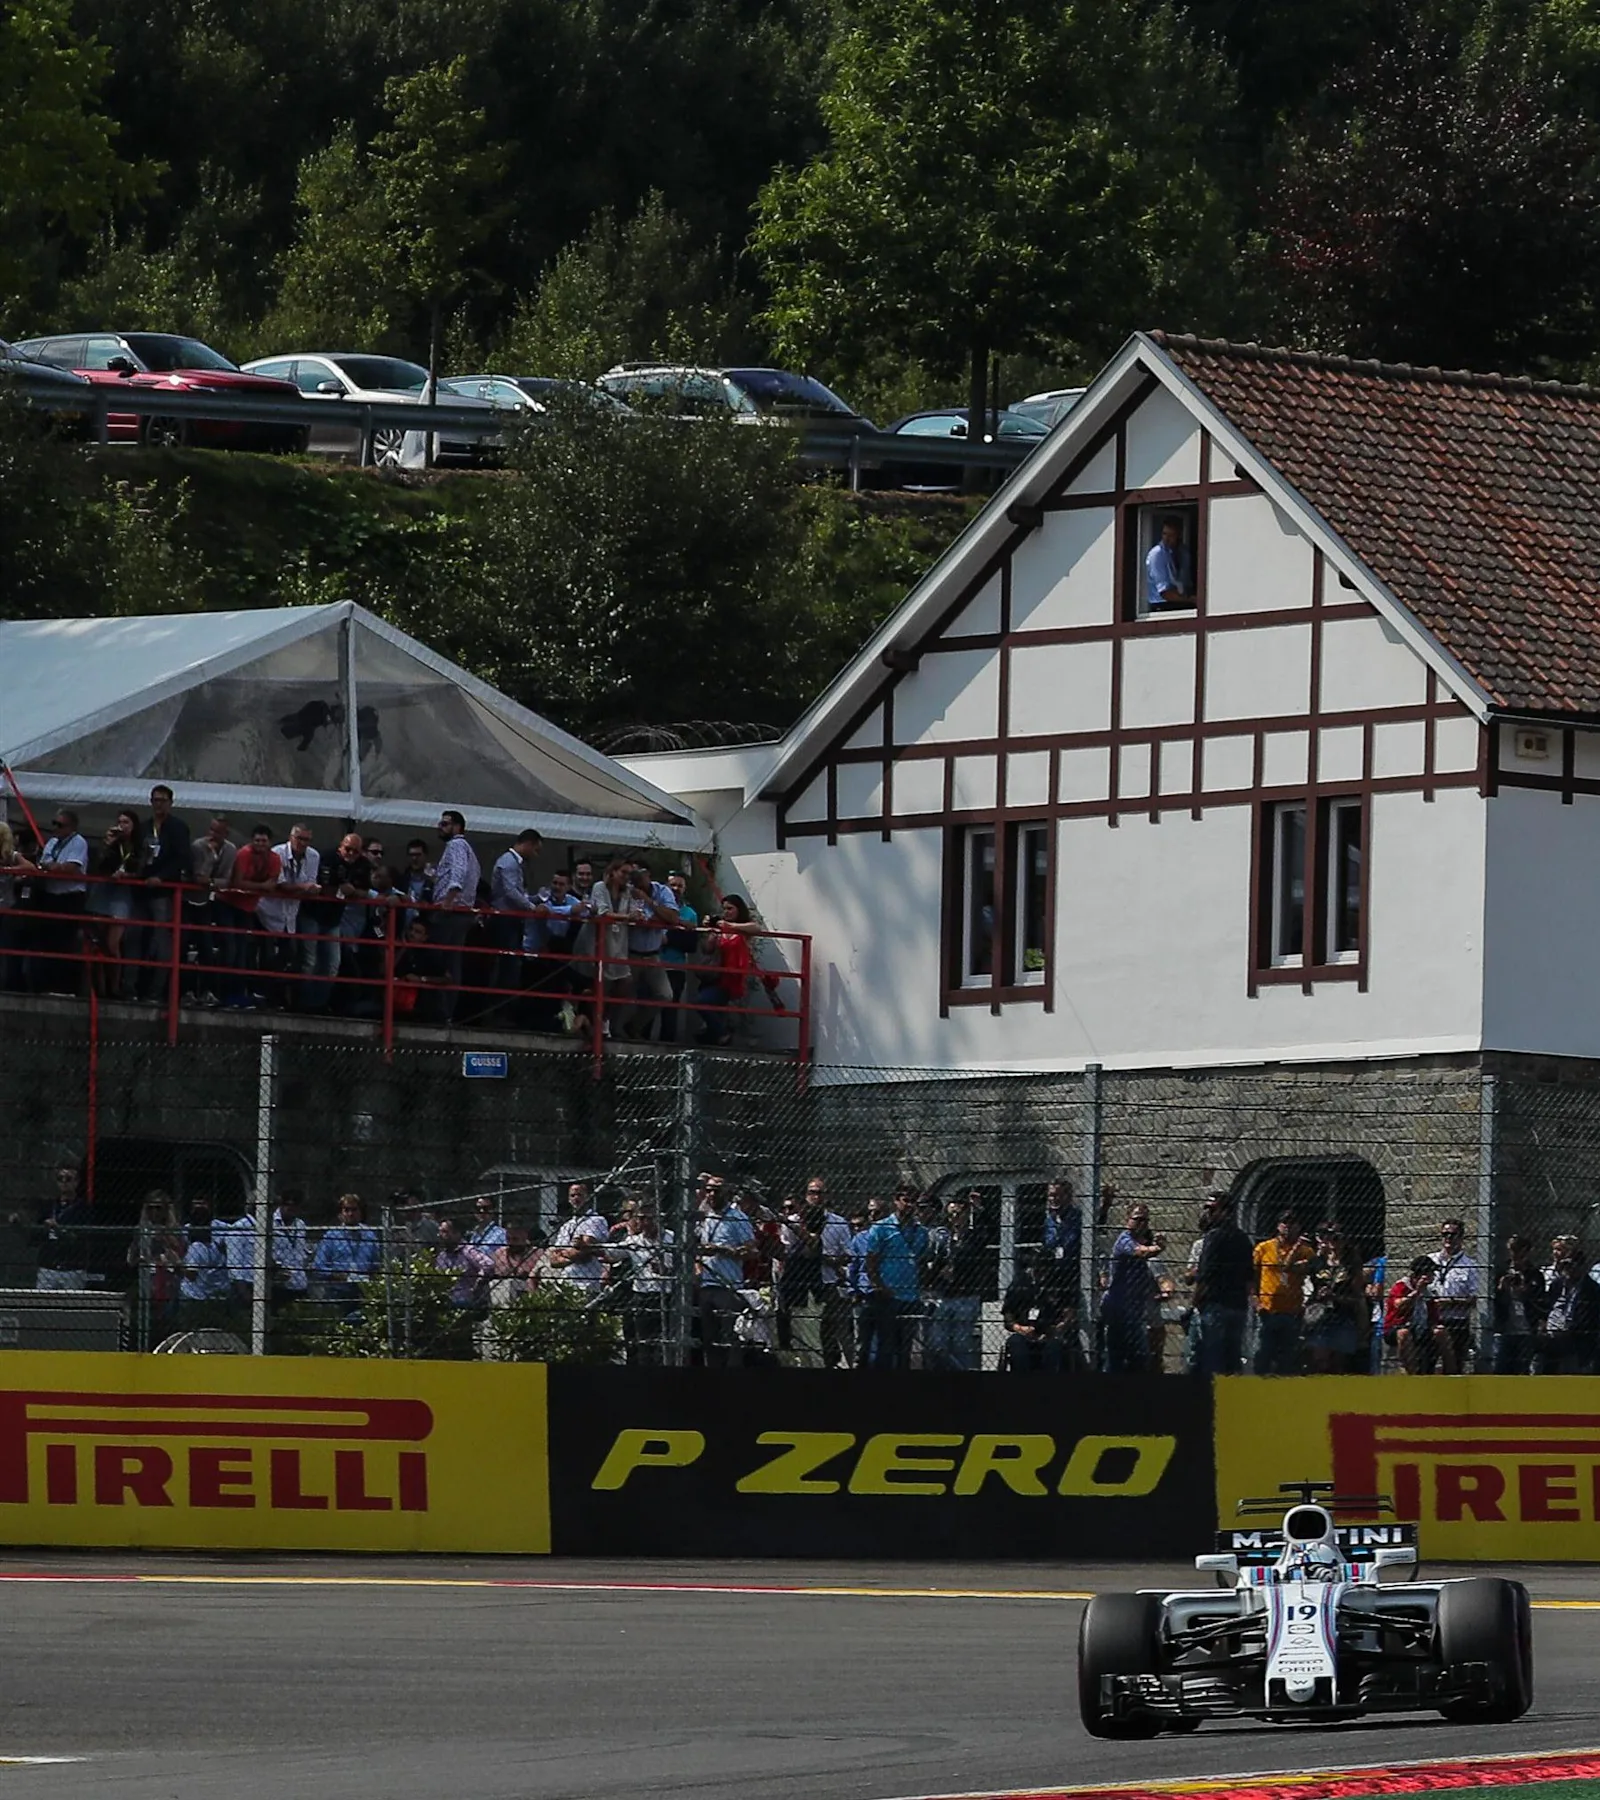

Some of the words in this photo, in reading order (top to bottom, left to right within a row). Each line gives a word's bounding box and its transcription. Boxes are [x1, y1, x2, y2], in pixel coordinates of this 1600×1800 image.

[0, 1390, 434, 1511] PIRELLI
[590, 1429, 706, 1491] P
[735, 1430, 1177, 1497] ZERO
[1232, 1527, 1403, 1549] MTINI
[1287, 1605, 1317, 1621] 19
